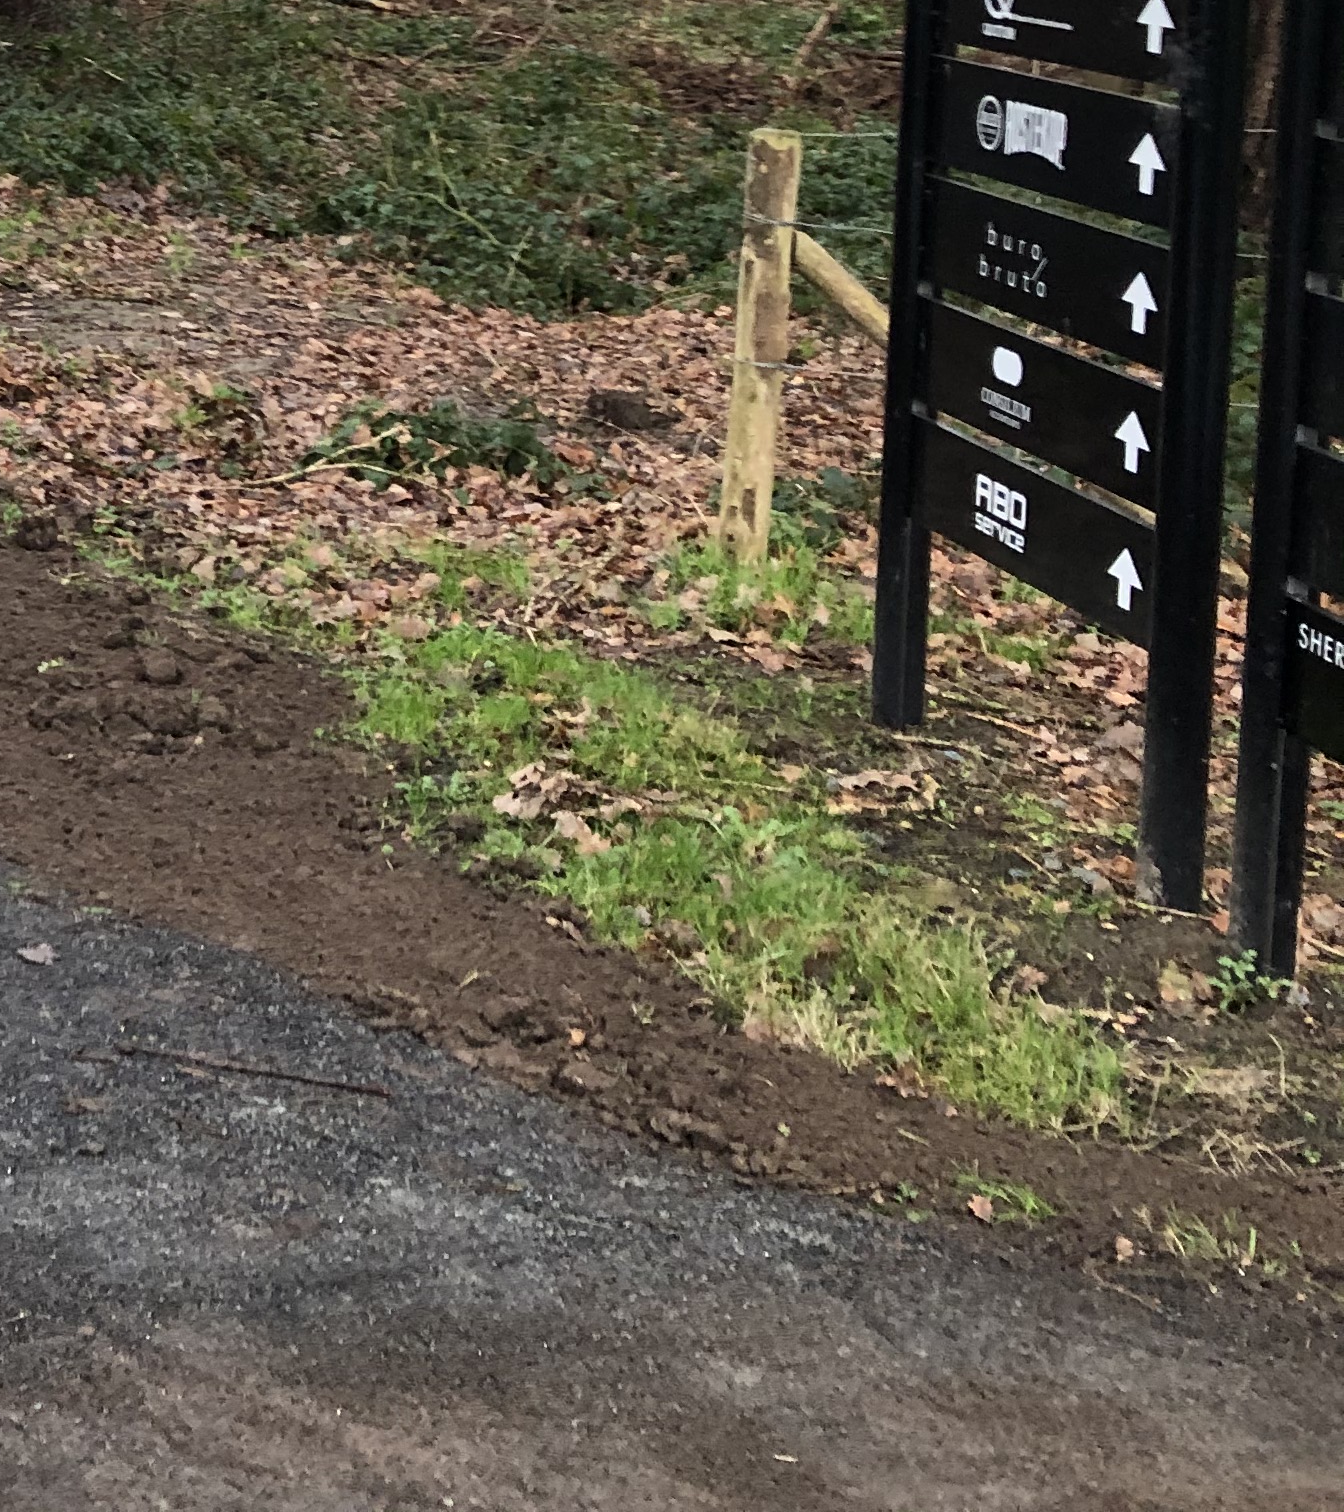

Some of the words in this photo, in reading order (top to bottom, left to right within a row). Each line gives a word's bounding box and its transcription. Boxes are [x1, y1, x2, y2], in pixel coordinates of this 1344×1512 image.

[986, 221, 1043, 261] buro
[975, 473, 1027, 530] ABO
[974, 511, 1025, 554] service
